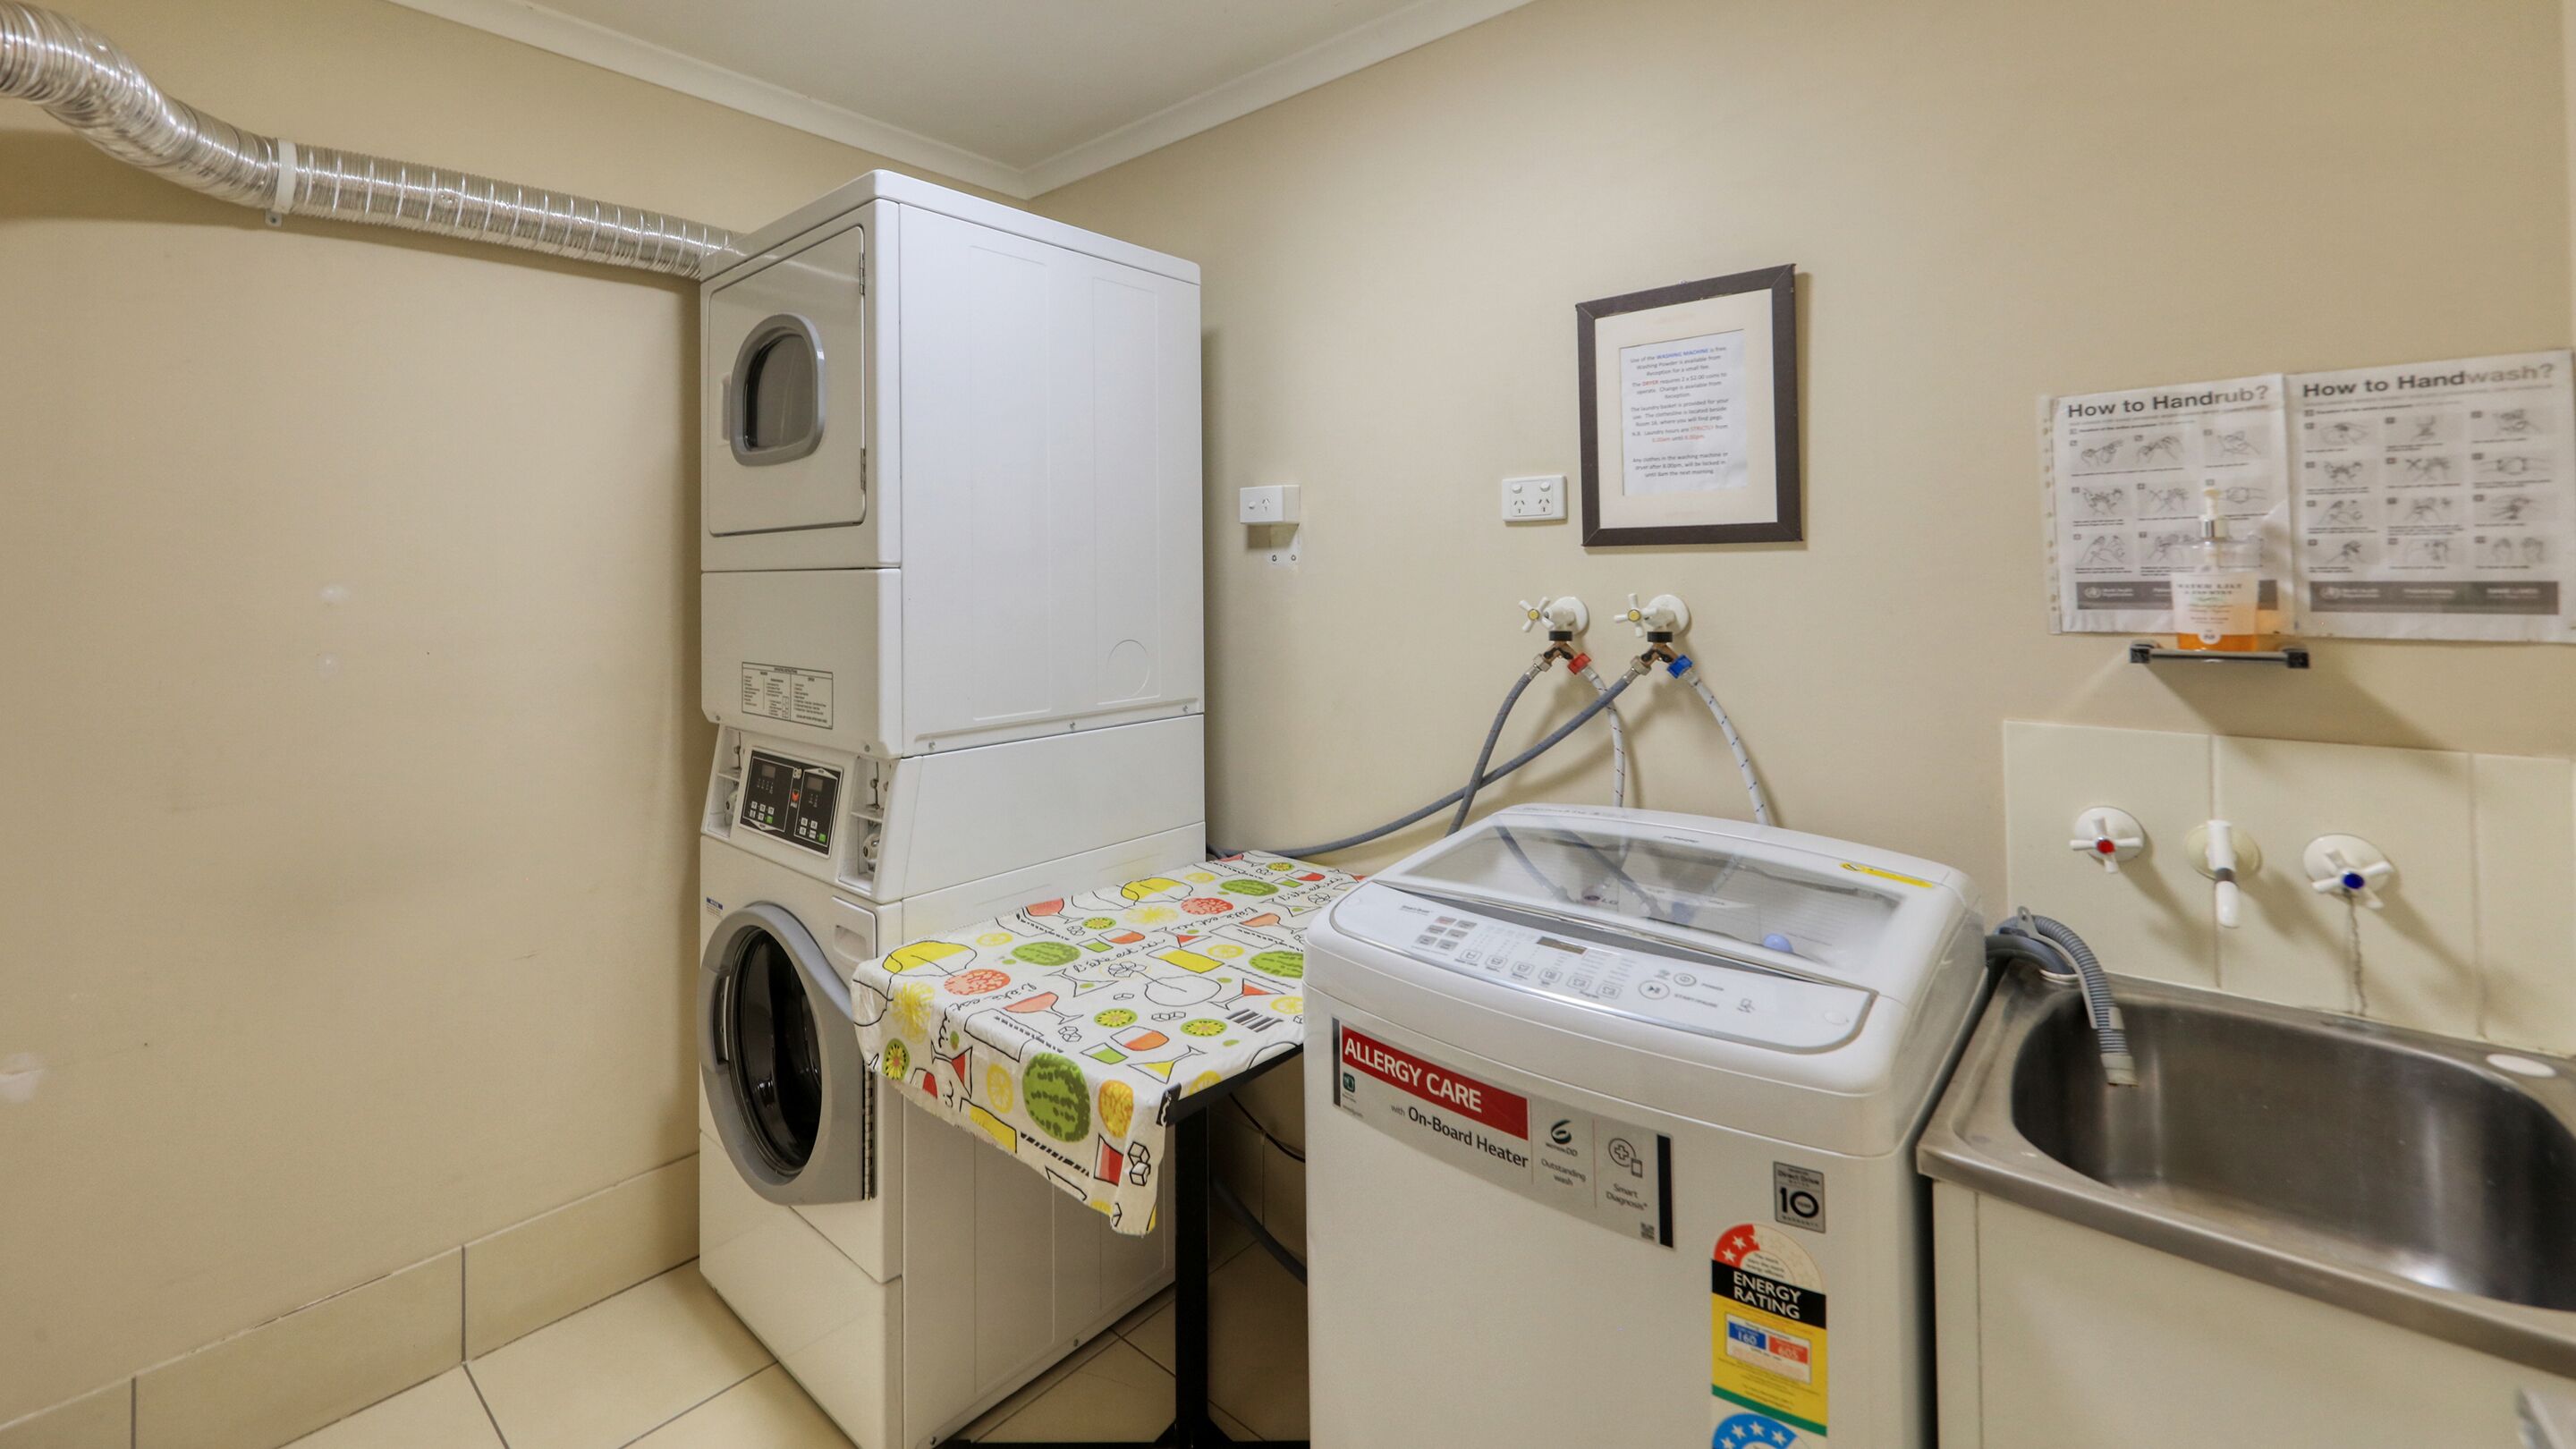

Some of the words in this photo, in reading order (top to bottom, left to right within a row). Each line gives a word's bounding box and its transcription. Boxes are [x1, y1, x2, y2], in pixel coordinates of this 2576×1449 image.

[2302, 382, 2356, 397] How
[2365, 379, 2388, 392] to
[2398, 363, 2555, 390] Handwash?
[2068, 402, 2116, 418] How
[2123, 399, 2145, 413] to
[2152, 385, 2269, 410] Handrub?
[1344, 1038, 1422, 1087] ALLERGY
[1426, 1073, 1482, 1113] CARE
[1391, 1105, 1405, 1116] with
[1408, 1106, 1472, 1146] On-Board
[1477, 1134, 1529, 1167] Heater
[1541, 1158, 1586, 1182] Outstanding
[1614, 1182, 1638, 1199] Smart
[1779, 1186, 1819, 1219] 10
[1733, 1270, 1801, 1304] ENERGY
[1733, 1286, 1801, 1319] RATING
